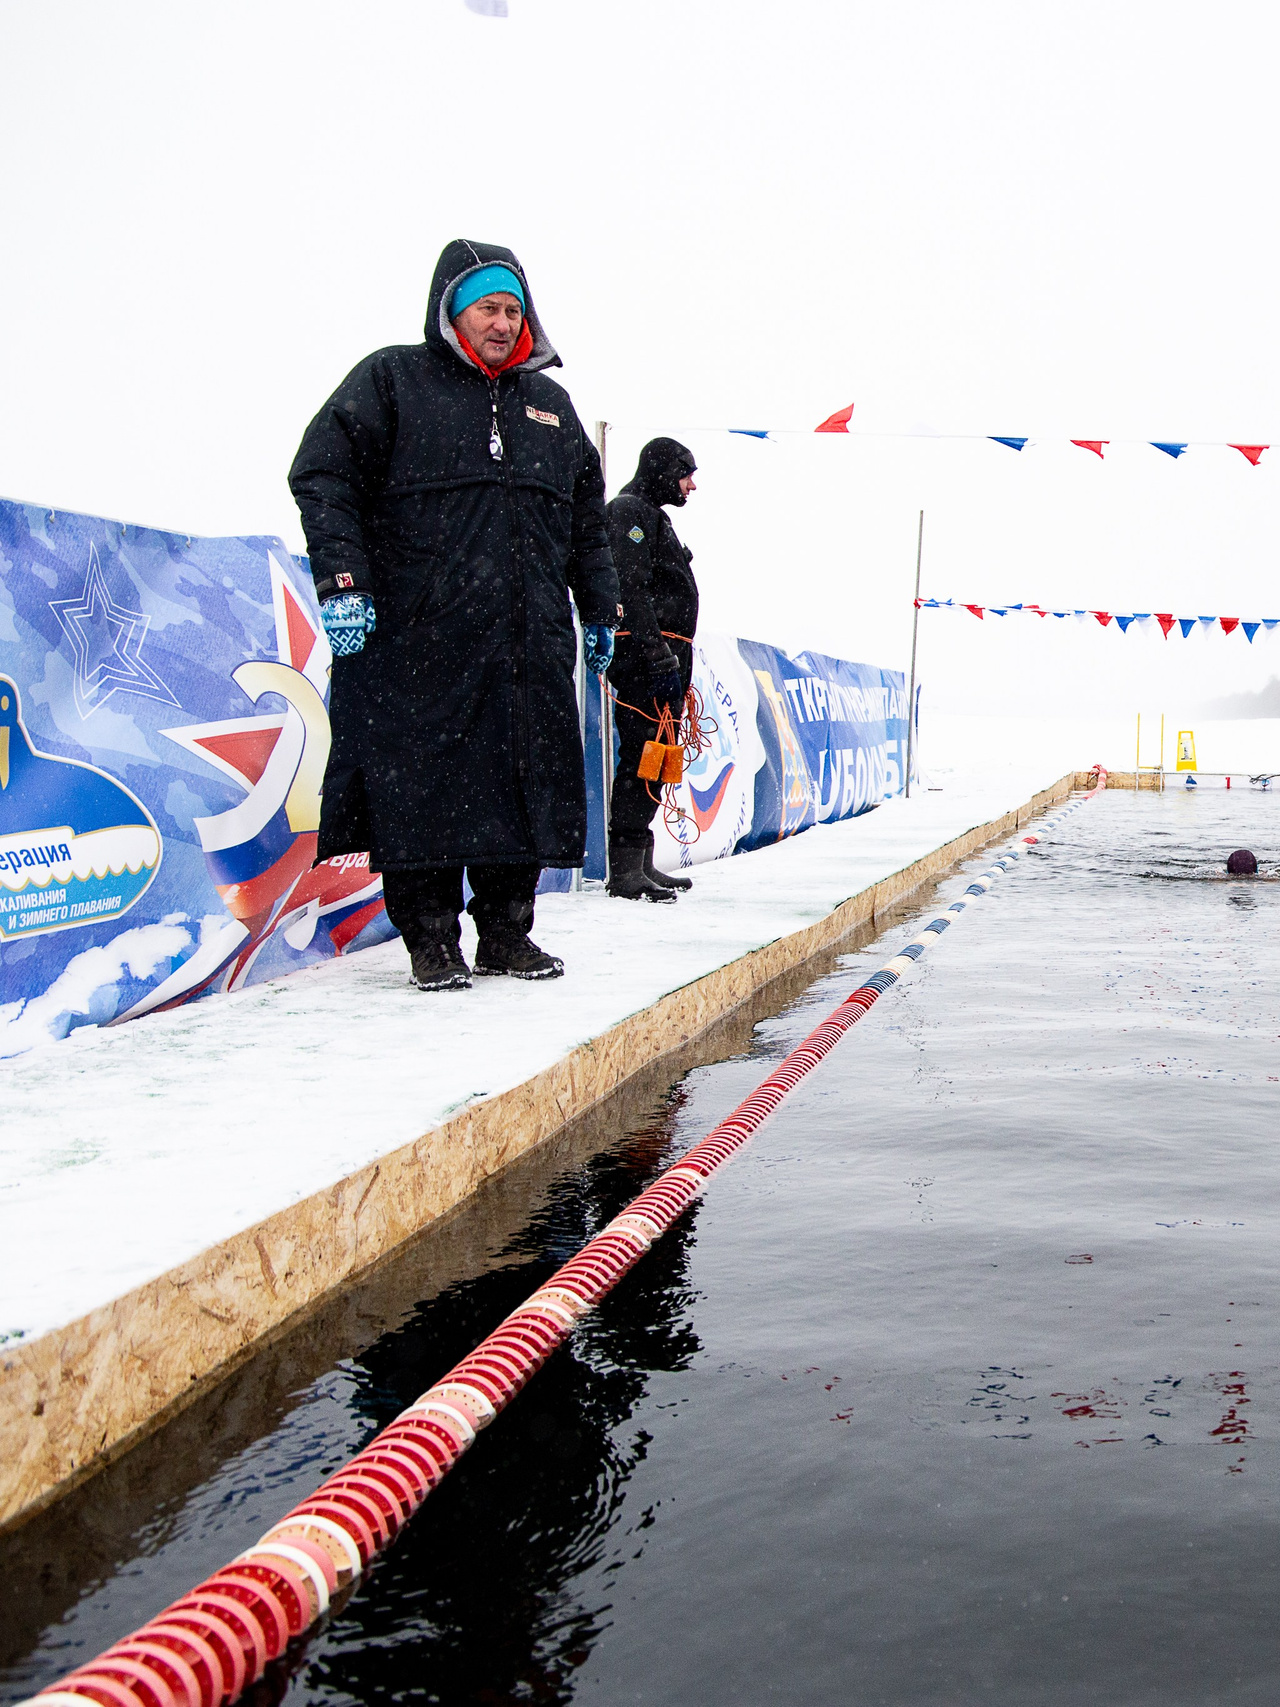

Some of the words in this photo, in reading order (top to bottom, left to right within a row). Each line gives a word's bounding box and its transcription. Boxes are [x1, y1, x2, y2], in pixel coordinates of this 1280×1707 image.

[1225, 776, 1230, 789] 1
[0, 843, 72, 874] ерация
[0, 888, 67, 913] КАЛИВАНИЯ
[8, 914, 17, 930] И
[19, 905, 69, 928] ЗИМНЕГО
[69, 895, 122, 918] ПЛАВАНИЯ
